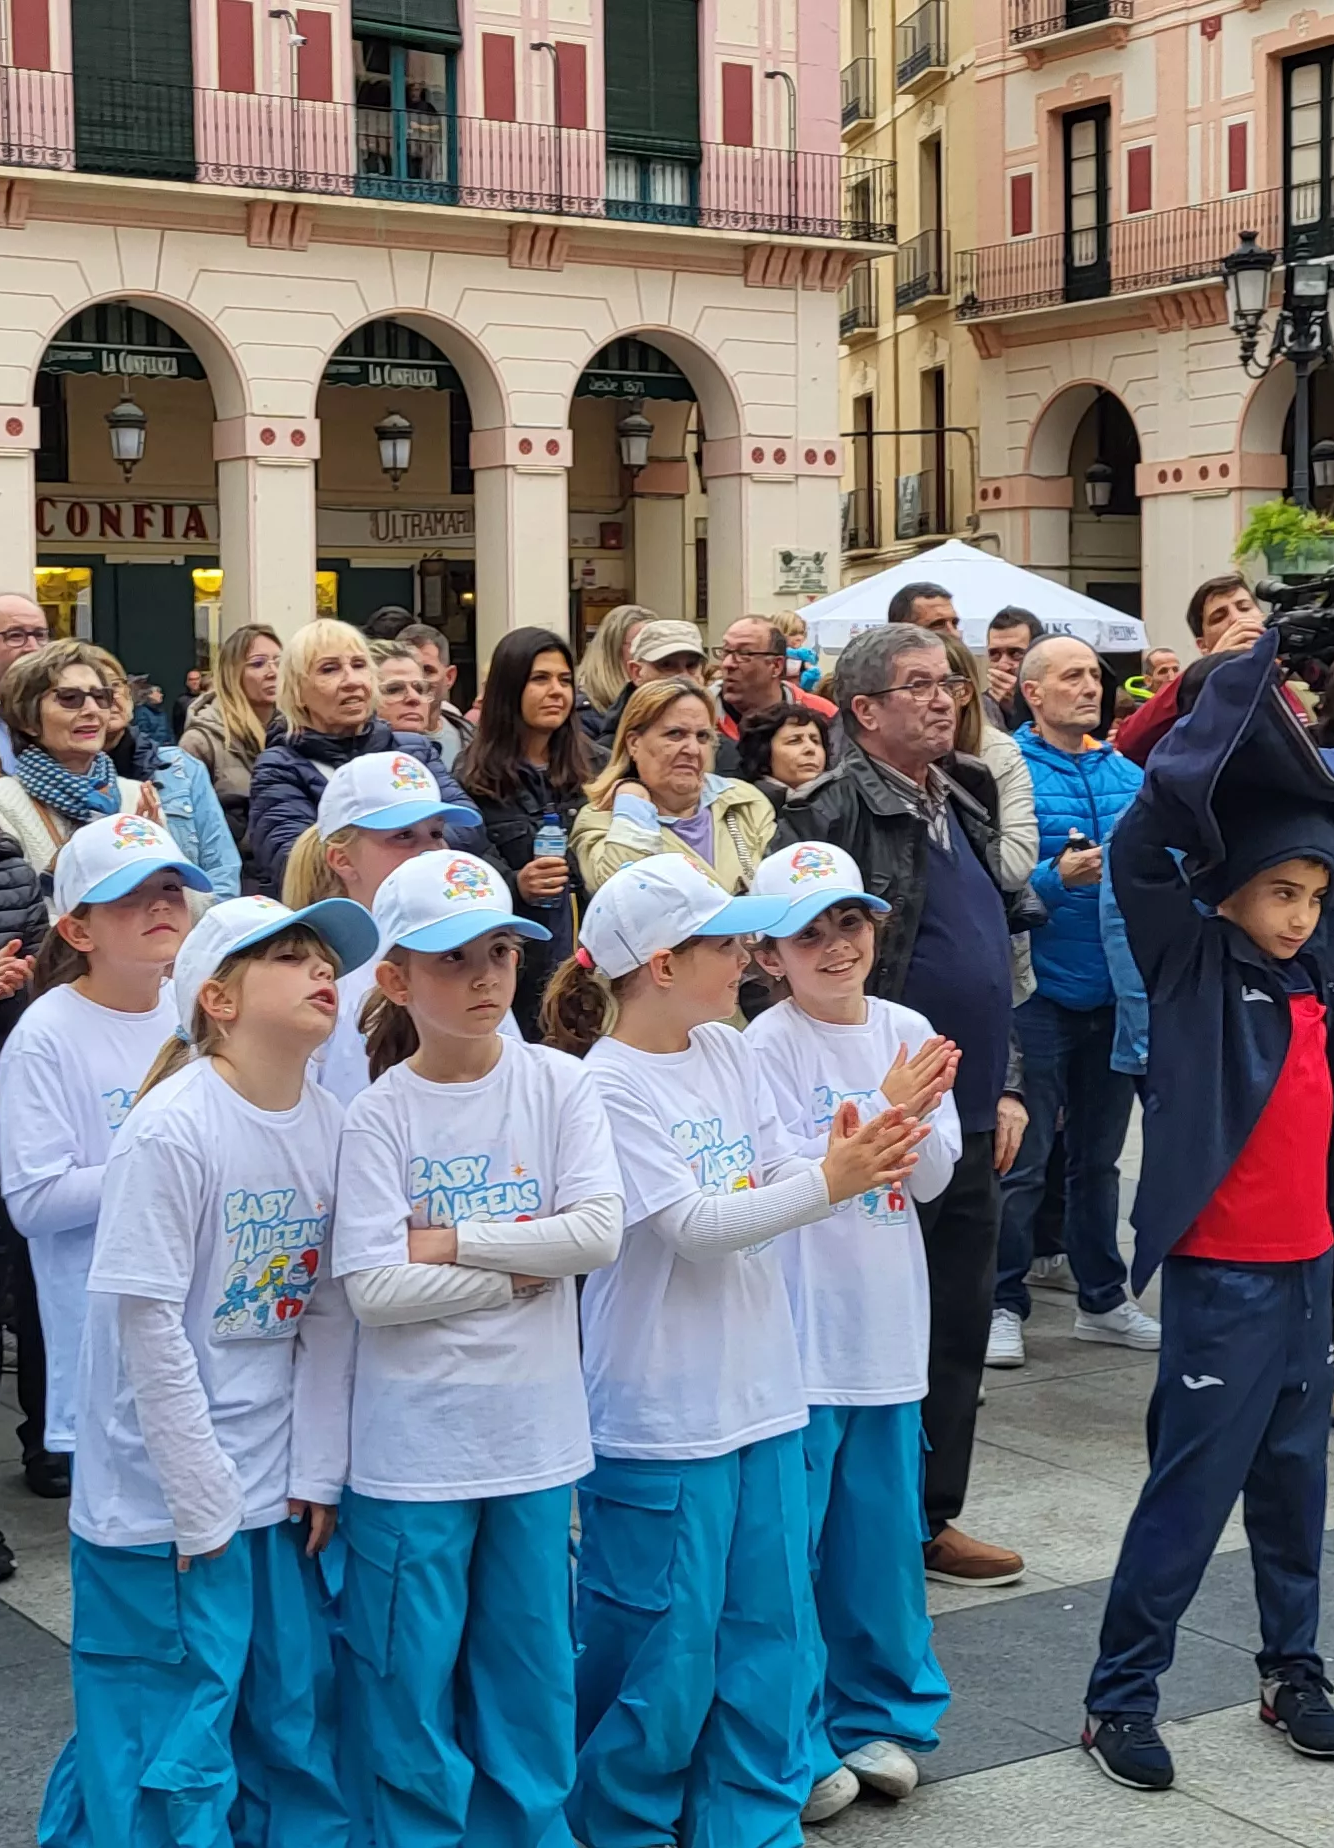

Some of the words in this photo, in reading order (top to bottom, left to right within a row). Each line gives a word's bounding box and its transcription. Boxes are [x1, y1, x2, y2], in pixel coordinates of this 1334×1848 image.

[36, 496, 219, 540] CONFIA
[409, 1154, 491, 1200] BABY
[224, 1188, 297, 1234] BABY
